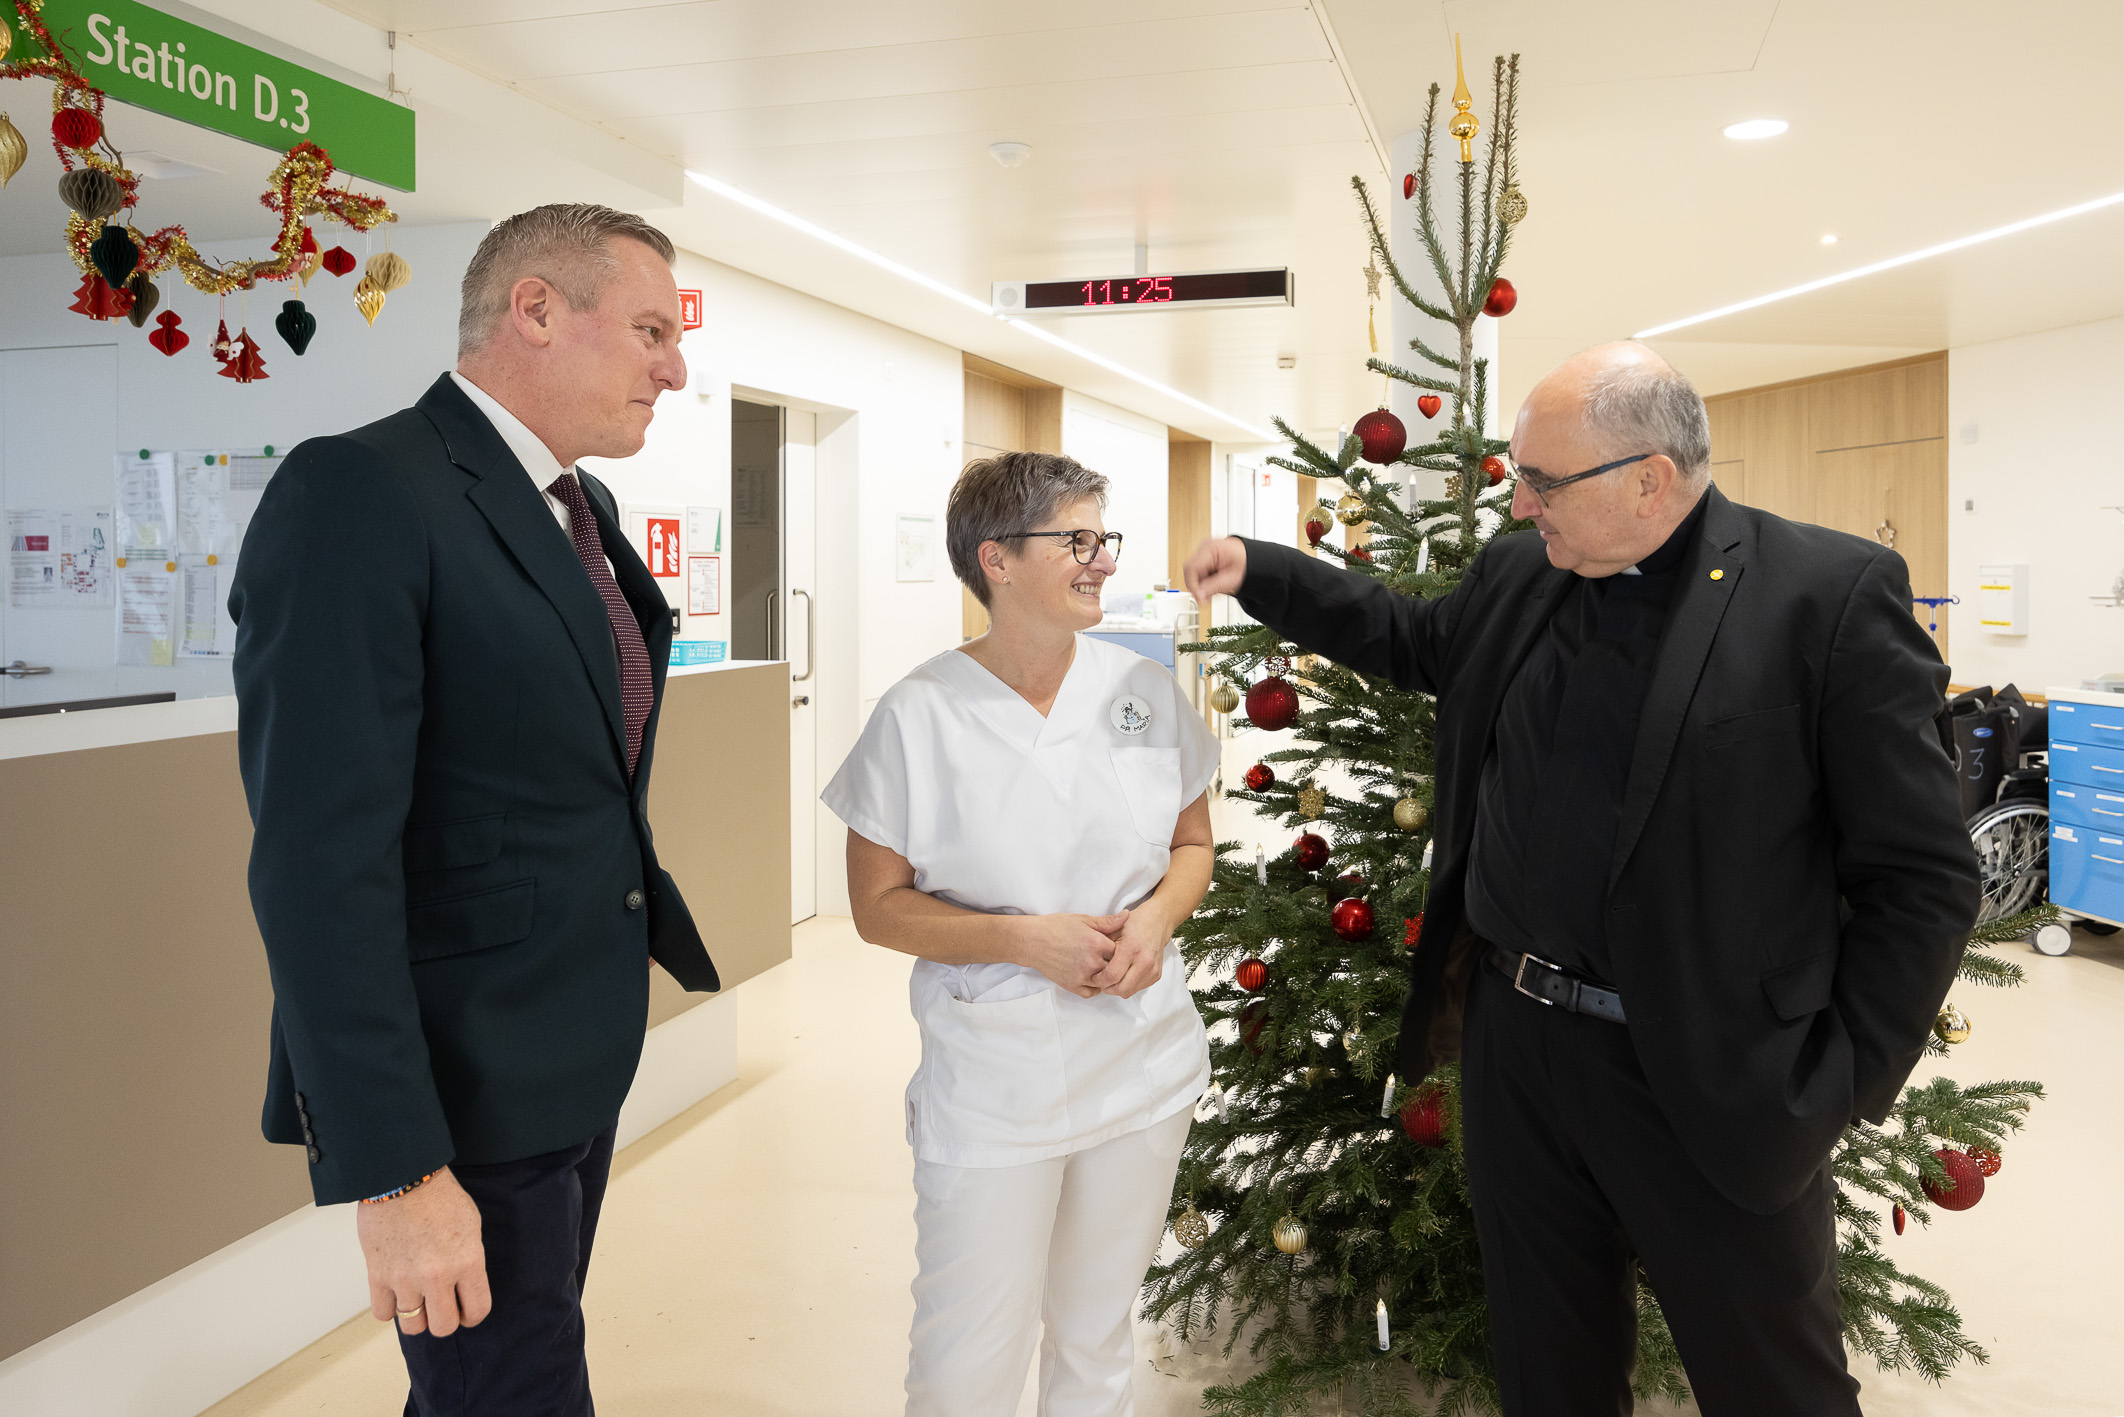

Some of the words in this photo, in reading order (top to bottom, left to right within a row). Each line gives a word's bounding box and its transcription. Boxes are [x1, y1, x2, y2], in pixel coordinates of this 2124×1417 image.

[87, 13, 236, 111] Station
[255, 74, 310, 134] D.3
[1081, 277, 1173, 306] 11:25
